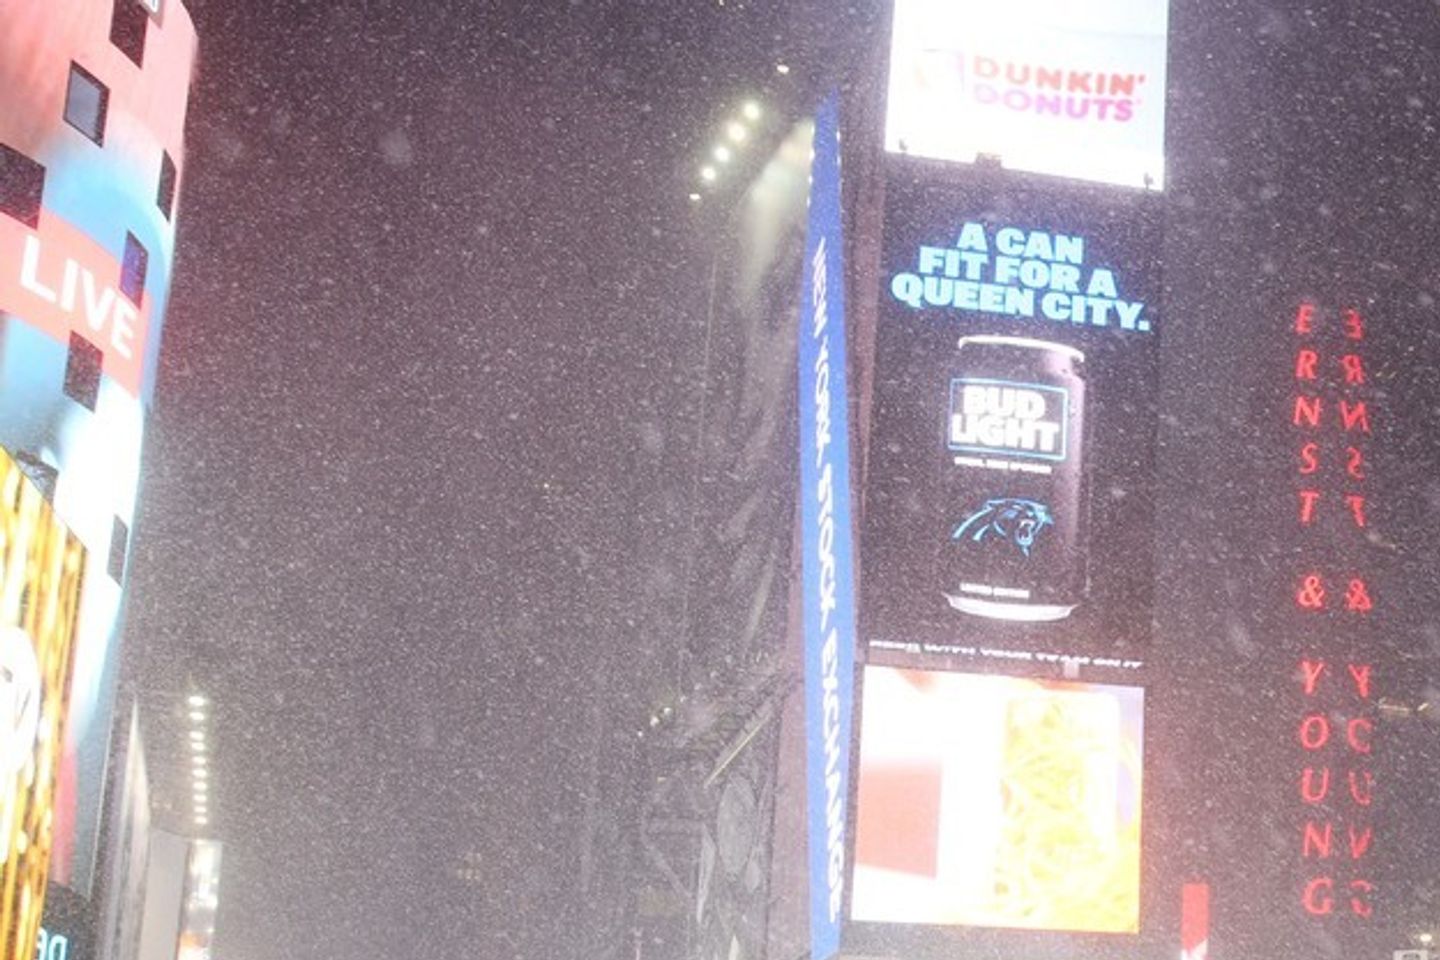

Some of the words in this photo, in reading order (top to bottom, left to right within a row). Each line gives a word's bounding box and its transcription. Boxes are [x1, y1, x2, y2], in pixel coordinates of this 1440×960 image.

[973, 54, 1146, 97] DUNKIN'
[973, 83, 1135, 122] DONUTS
[918, 245, 989, 280] FIT
[995, 255, 1081, 293] FOR
[1087, 268, 1118, 298] A
[957, 222, 989, 252] A
[995, 227, 1084, 264] CAN
[20, 233, 138, 361] LIVE
[811, 236, 828, 339] NEW
[890, 272, 1035, 317] QUEEN
[1041, 291, 1151, 332] CITY.
[815, 335, 832, 469] YORK
[950, 412, 1061, 452] LIGHT
[962, 384, 1046, 421] BUD
[1294, 304, 1320, 523] ERNST
[817, 462, 837, 633] STOCK
[1297, 574, 1325, 612] &
[821, 627, 845, 924] EXCHANGE
[1299, 660, 1333, 917] YOUNG
